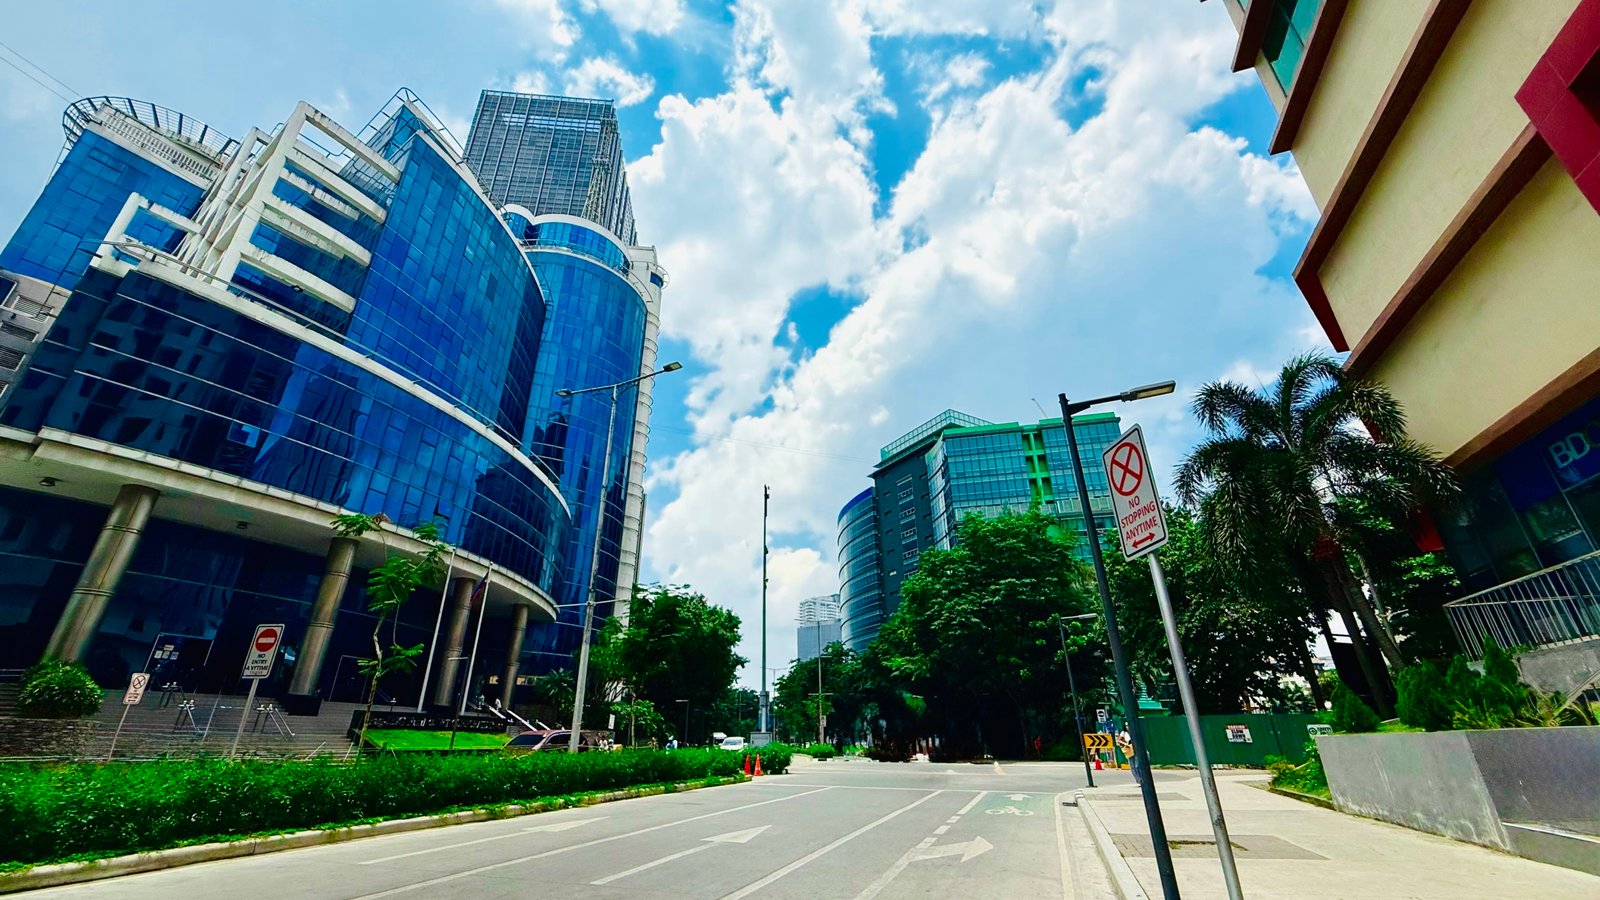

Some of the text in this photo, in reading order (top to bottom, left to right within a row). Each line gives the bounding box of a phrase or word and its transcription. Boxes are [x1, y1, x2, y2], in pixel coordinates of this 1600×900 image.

[1121, 501, 1156, 529] STOPPING
[1128, 495, 1140, 509] NO
[1125, 515, 1158, 542] ANYTIME
